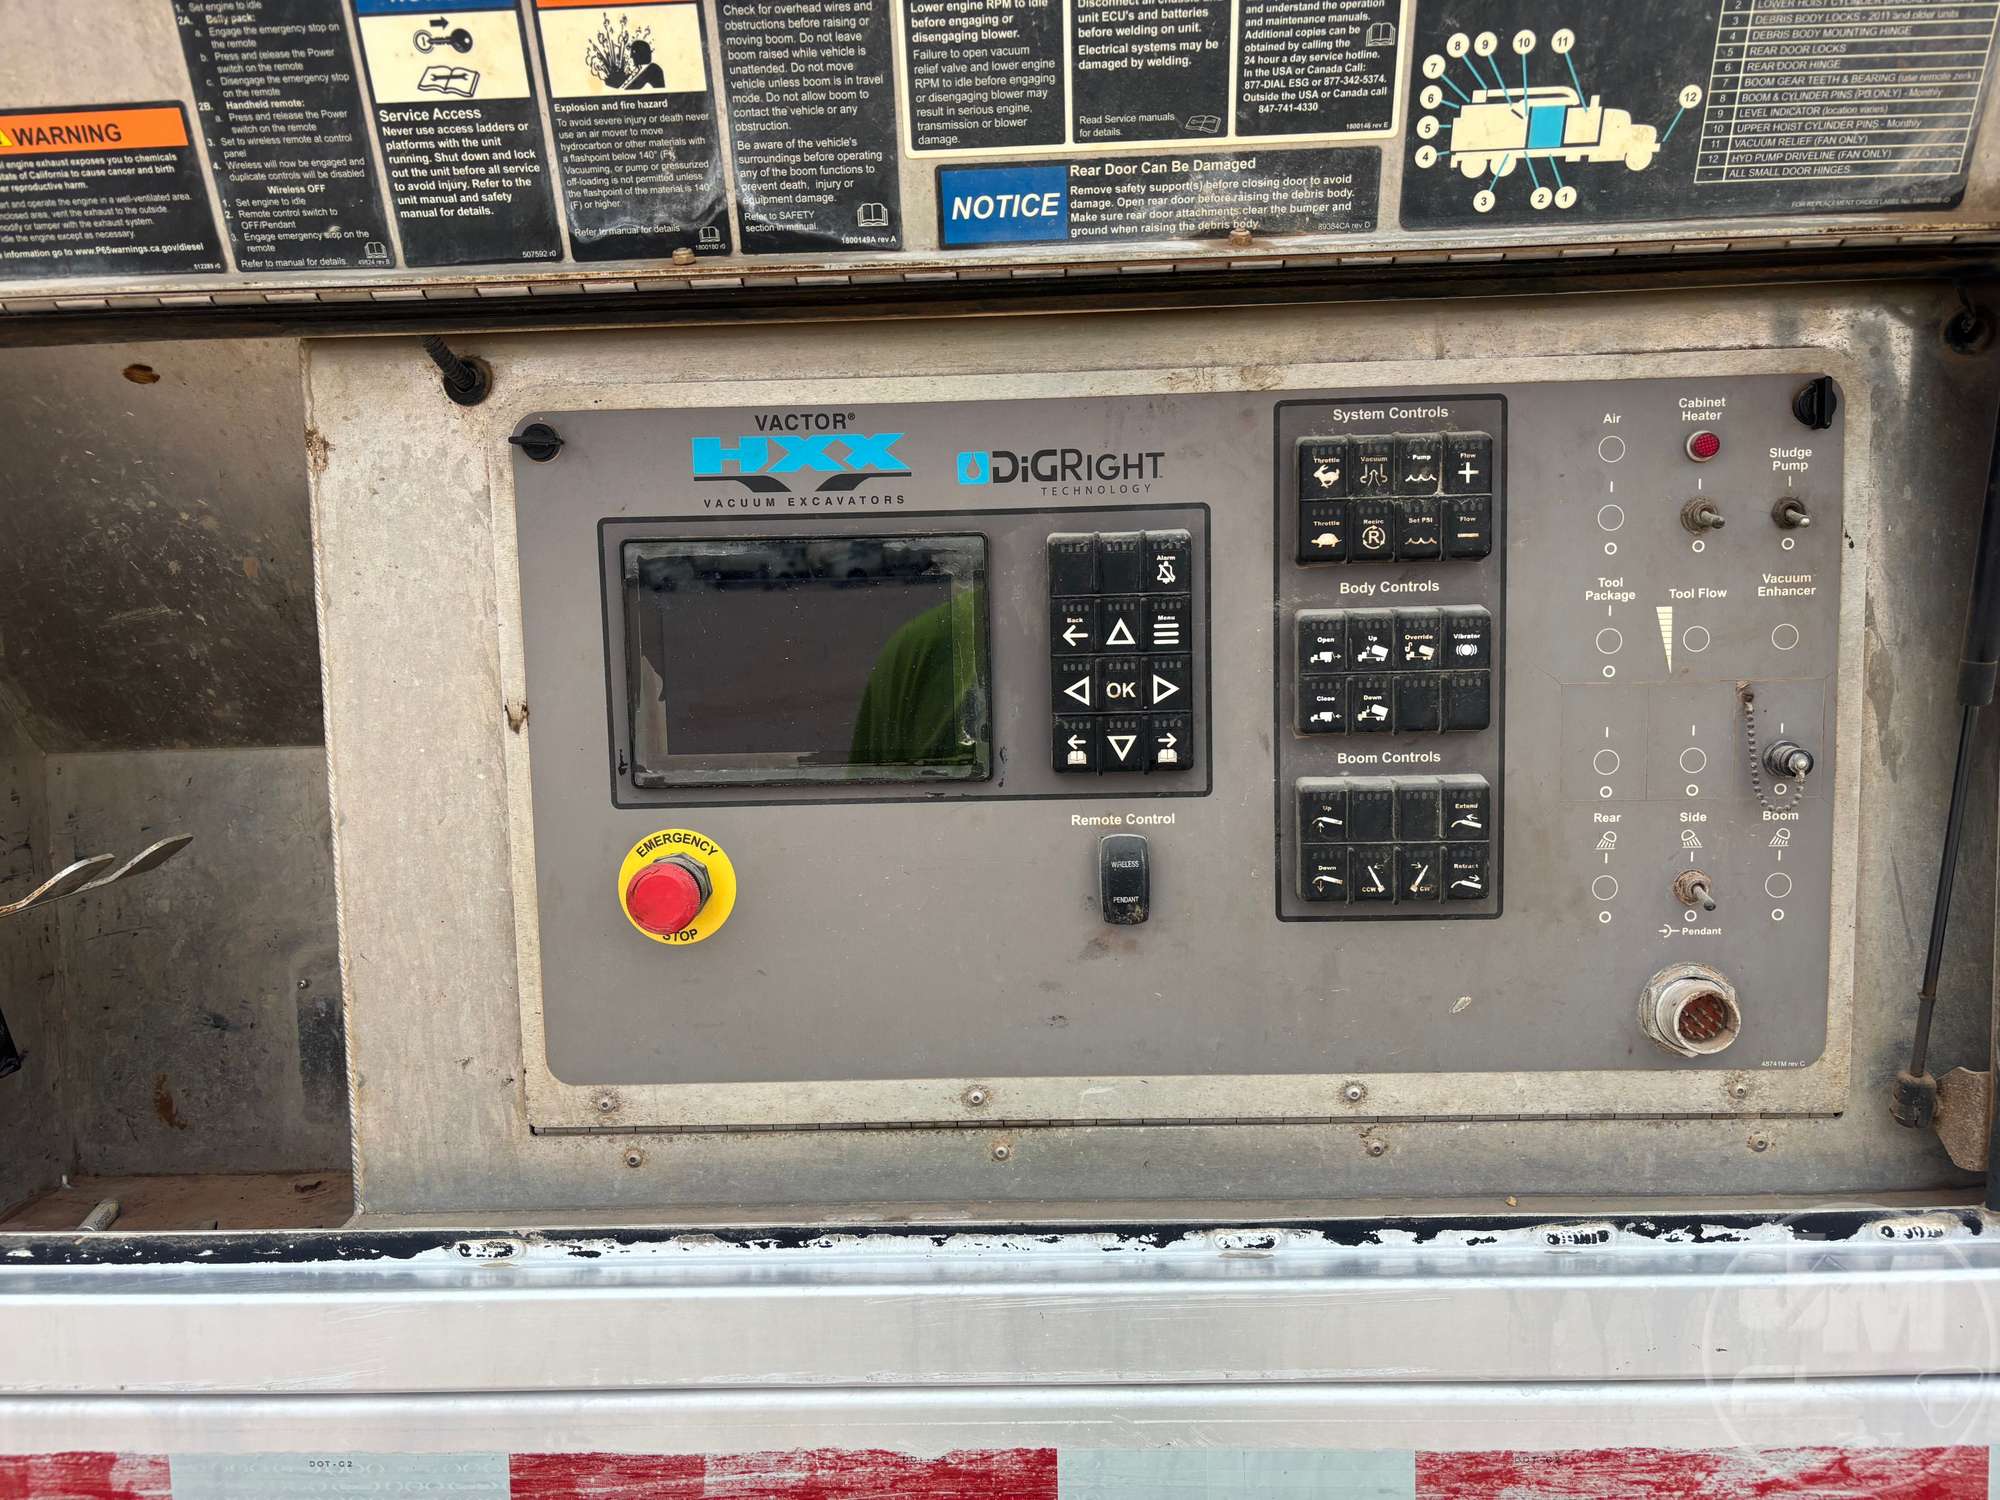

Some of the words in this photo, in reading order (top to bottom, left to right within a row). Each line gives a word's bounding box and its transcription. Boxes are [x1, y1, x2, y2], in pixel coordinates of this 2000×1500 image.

[911, 16, 945, 28] before
[948, 14, 998, 28] engaging
[1002, 15, 1013, 23] or
[912, 30, 978, 43] disengaging
[981, 29, 1019, 39] blower.
[1557, 36, 1568, 46] 11
[1455, 41, 1460, 50] 8
[1482, 40, 1488, 49] 9
[1518, 38, 1530, 48] 10
[1750, 46, 1777, 55] REAR
[1780, 45, 1810, 54] DOOR
[1812, 44, 1846, 53] LOCKS
[1244, 68, 1252, 77] In
[1255, 68, 1269, 76] the
[1272, 66, 1292, 76] USA
[1307, 64, 1342, 74] Canada
[1344, 62, 1365, 72] Call:
[1431, 63, 1437, 72] 7
[1244, 79, 1286, 89] 877-DIAL
[1288, 78, 1309, 87] ESG
[1324, 74, 1386, 85] 877-342-5374.
[1428, 93, 1433, 103] 6
[1686, 92, 1696, 102] 12
[554, 103, 599, 113] Explosion
[601, 101, 618, 110] and
[620, 101, 635, 109] fire
[637, 98, 668, 108] hazard
[1258, 102, 1318, 113] 847-741-4330
[379, 109, 429, 122] Service
[433, 108, 481, 120] Access
[382, 126, 412, 136] Never
[437, 125, 473, 134] access
[476, 122, 515, 132] ladders
[1425, 124, 1430, 132] 5
[11, 123, 121, 146] WARNING
[1735, 138, 1776, 147] VACUUM
[1778, 136, 1812, 145] RELIEF
[1814, 136, 1837, 145] (FAN
[1838, 133, 1867, 144] ONLY)
[385, 140, 435, 152] platforms
[437, 138, 459, 148] with
[461, 137, 478, 147] the
[481, 136, 501, 146] unit
[388, 154, 432, 164] running.
[434, 152, 459, 162] Shut
[461, 151, 489, 161] down
[492, 150, 511, 160] and
[514, 149, 536, 159] lock
[1422, 152, 1428, 161] 4
[391, 168, 409, 177] out
[410, 167, 427, 176] the
[430, 166, 450, 176] unit
[452, 165, 485, 175] before
[488, 164, 500, 174] all
[502, 163, 540, 173] service
[1070, 165, 1101, 176] Rear
[1105, 163, 1137, 175] Door
[1141, 162, 1167, 173] Can
[1172, 160, 1189, 172] Be
[1193, 157, 1255, 173] Damaged
[1729, 169, 1746, 178] ALL
[1749, 168, 1780, 177] SMALL
[1782, 166, 1812, 176] DOOR
[1814, 165, 1851, 174] HINGES
[267, 185, 305, 194] Wireless
[307, 184, 325, 192] OFF
[394, 182, 405, 191] to
[408, 180, 435, 190] avoid
[438, 180, 469, 191] injury.
[472, 178, 499, 188] Refer
[502, 178, 512, 187] to
[515, 177, 531, 186] the
[397, 195, 417, 204] unit
[419, 193, 457, 203] manual
[460, 192, 479, 202] and
[481, 192, 511, 202] safety
[1481, 198, 1487, 206] 3
[1538, 194, 1544, 203] 2
[1563, 194, 1568, 202] 1
[952, 192, 1060, 219] NOTICE
[400, 208, 437, 218] manual
[440, 207, 454, 216] for
[457, 206, 494, 216] details.
[1679, 398, 1726, 408] Cabinet
[1333, 409, 1384, 423] System
[1389, 406, 1448, 418] Controls
[1603, 414, 1621, 423] Air
[1682, 412, 1721, 421] Heater
[1770, 448, 1812, 459] Sludge
[1773, 461, 1808, 471] Pump
[1041, 483, 1150, 496] TECHNOLOGY
[704, 498, 774, 508] VACUUM
[788, 495, 904, 506] EXCAVATORS
[1598, 578, 1623, 588] Tool
[1763, 573, 1811, 584] Vacuum
[1340, 582, 1376, 596] Body
[1380, 580, 1439, 592] Controls
[1669, 588, 1694, 598] Tool
[1698, 588, 1727, 598] Flow
[1758, 586, 1816, 597] Enhancer
[1586, 590, 1635, 602] Package
[1106, 683, 1136, 698] OK
[1337, 753, 1377, 763] Boom
[1382, 751, 1440, 763] Controls
[1071, 814, 1121, 825] Remote
[1126, 813, 1174, 824] Control
[1594, 813, 1621, 823] Rear
[1680, 812, 1707, 823] Side
[1763, 811, 1799, 821] Boom
[636, 833, 718, 857] EMERGENCY
